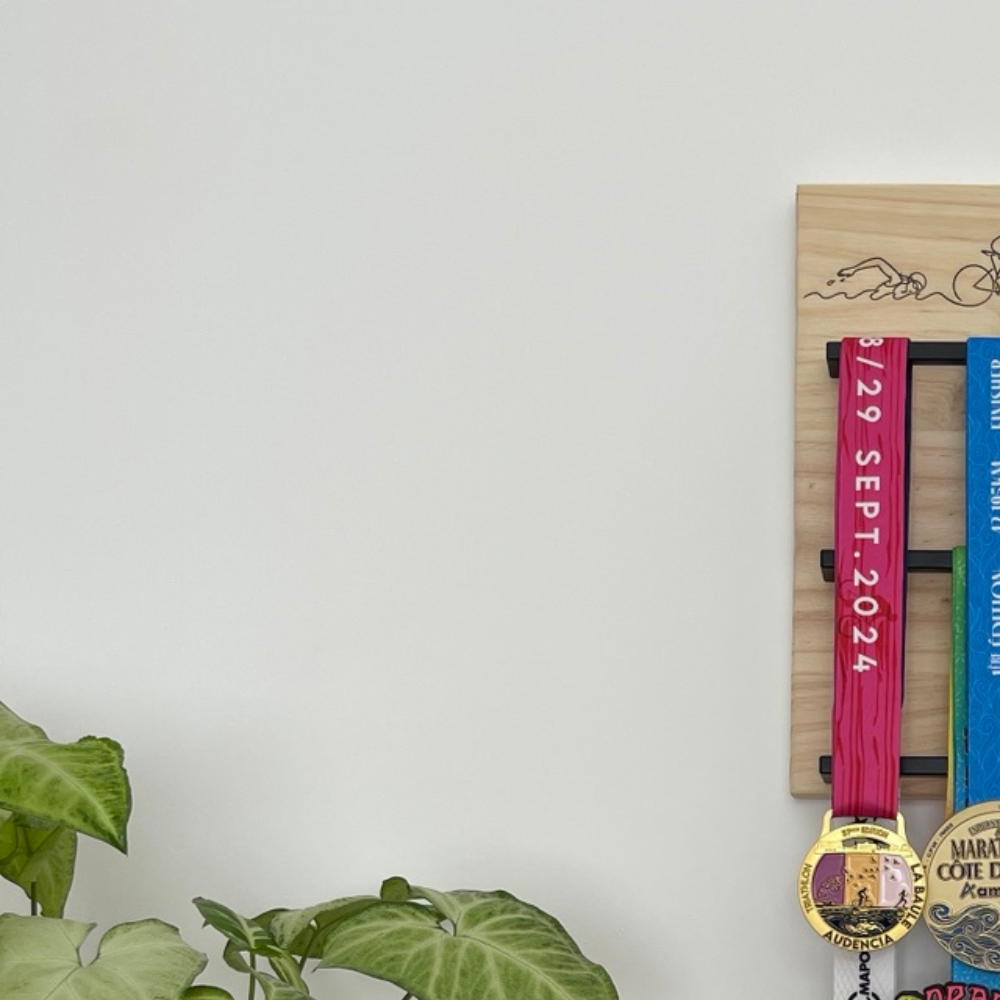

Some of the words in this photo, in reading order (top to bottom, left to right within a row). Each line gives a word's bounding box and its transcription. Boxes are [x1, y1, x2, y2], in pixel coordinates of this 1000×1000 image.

[910, 863, 922, 881] LA
[937, 859, 984, 881] CÔTE
[800, 863, 812, 914] TRIATHLON
[901, 886, 925, 930] BAULE
[823, 933, 895, 950] AUDENCIA
[858, 951, 870, 995] MAPO
